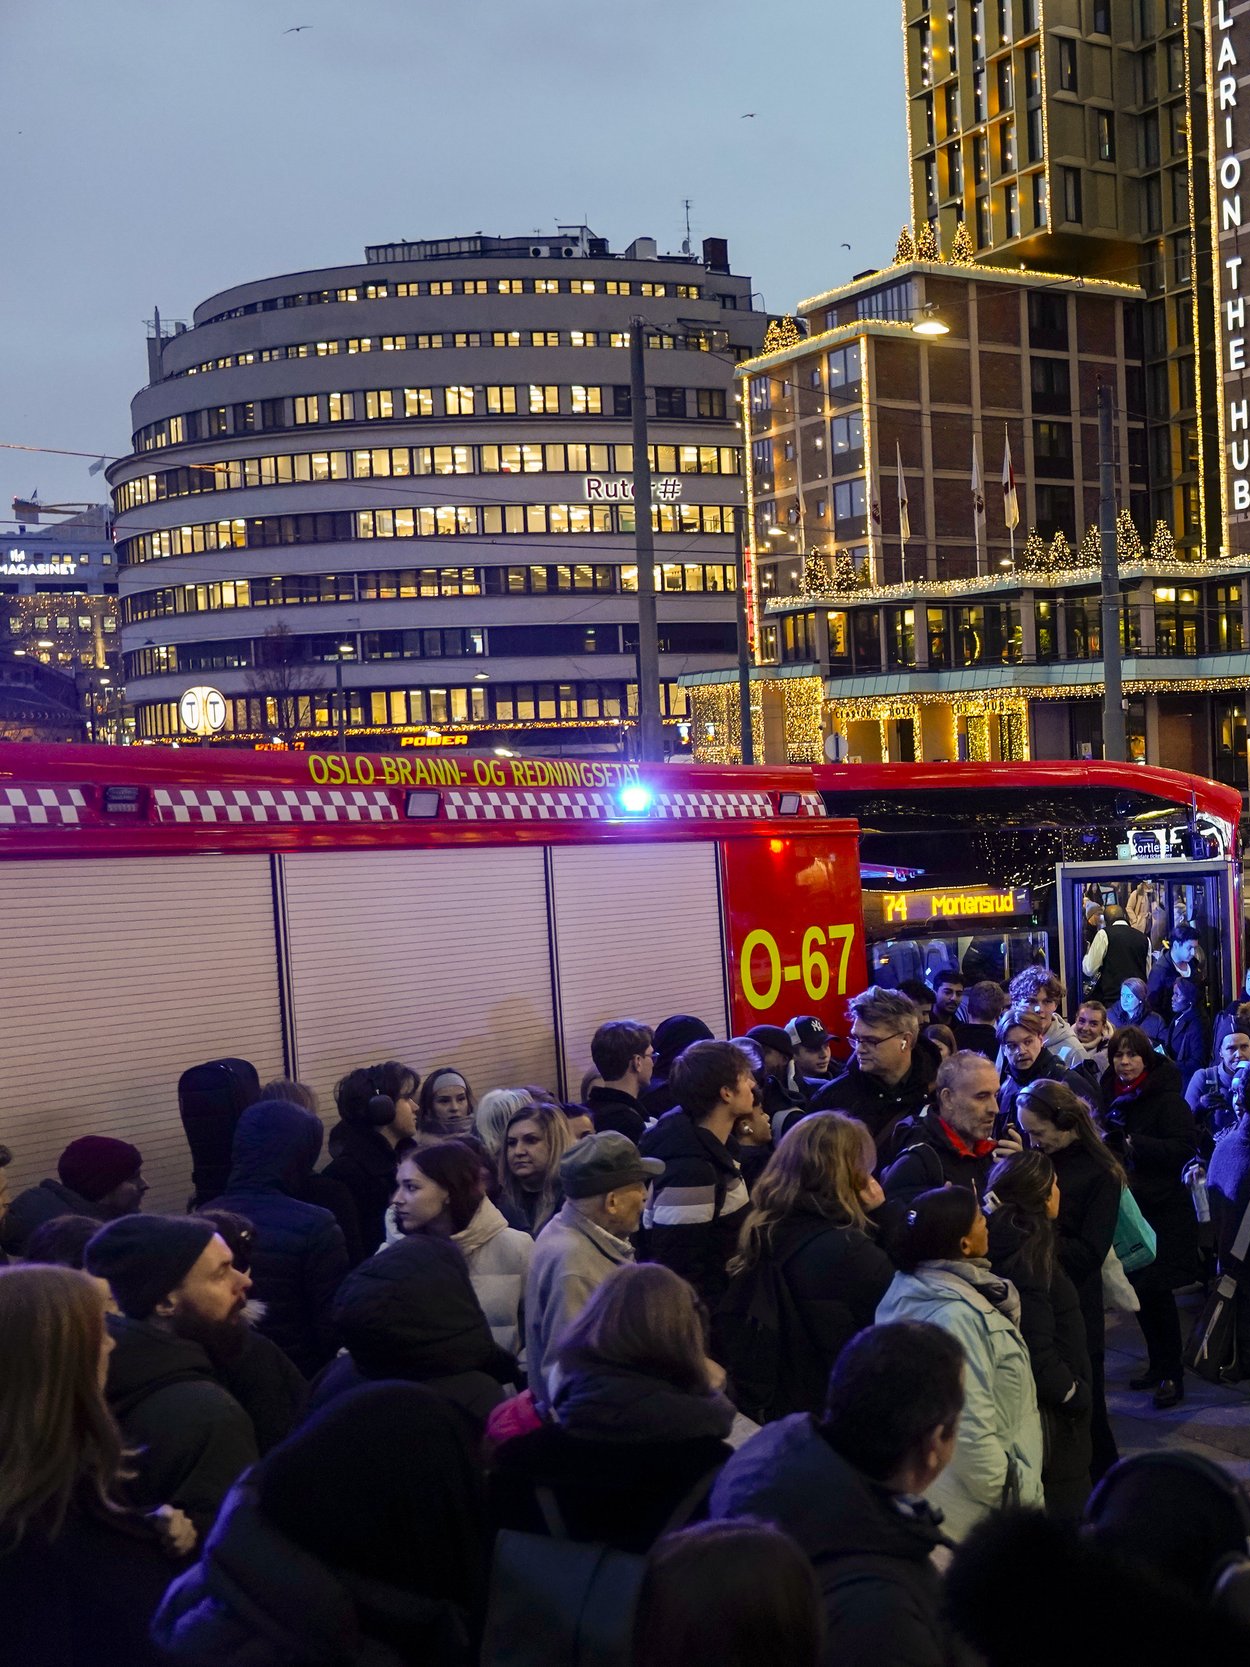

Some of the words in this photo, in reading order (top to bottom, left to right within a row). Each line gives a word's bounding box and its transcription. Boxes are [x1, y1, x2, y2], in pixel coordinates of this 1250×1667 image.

[1226, 257, 1246, 371] THE
[1230, 399, 1250, 511] HUB
[585, 477, 682, 499] Rut#
[984, 702, 1004, 711] HUB
[401, 735, 468, 747] POWER
[308, 754, 375, 785] OSLO
[380, 756, 468, 785] BRANN-
[473, 759, 506, 787] OG
[510, 760, 641, 788] REDNINGSETAT
[1132, 842, 1174, 854] Kortleer
[883, 895, 908, 922] 74
[931, 891, 1014, 917] Mortensrud
